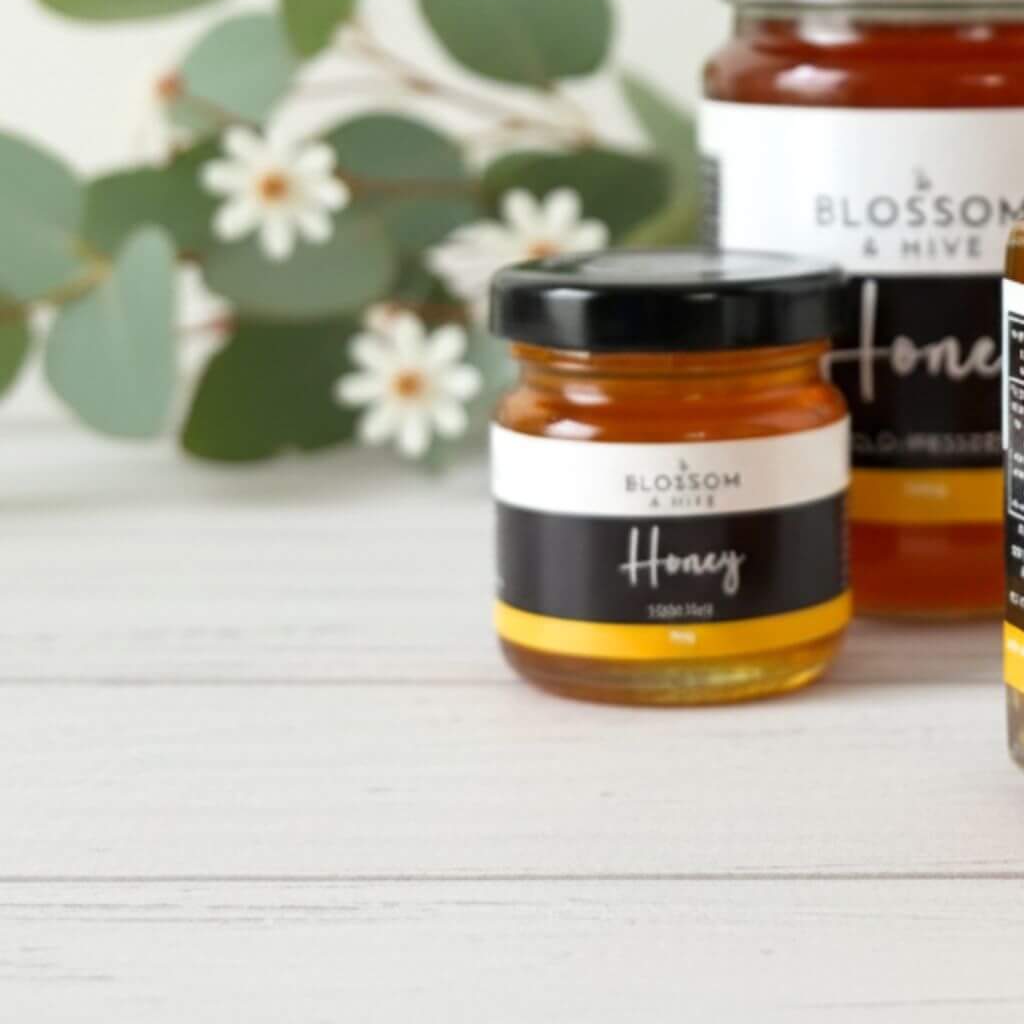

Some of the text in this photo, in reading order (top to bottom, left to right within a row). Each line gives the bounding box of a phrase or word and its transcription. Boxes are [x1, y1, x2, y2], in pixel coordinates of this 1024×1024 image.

[901, 237, 982, 258] HIVE
[625, 472, 741, 493] BLOSSOM
[618, 525, 745, 597] Honey
